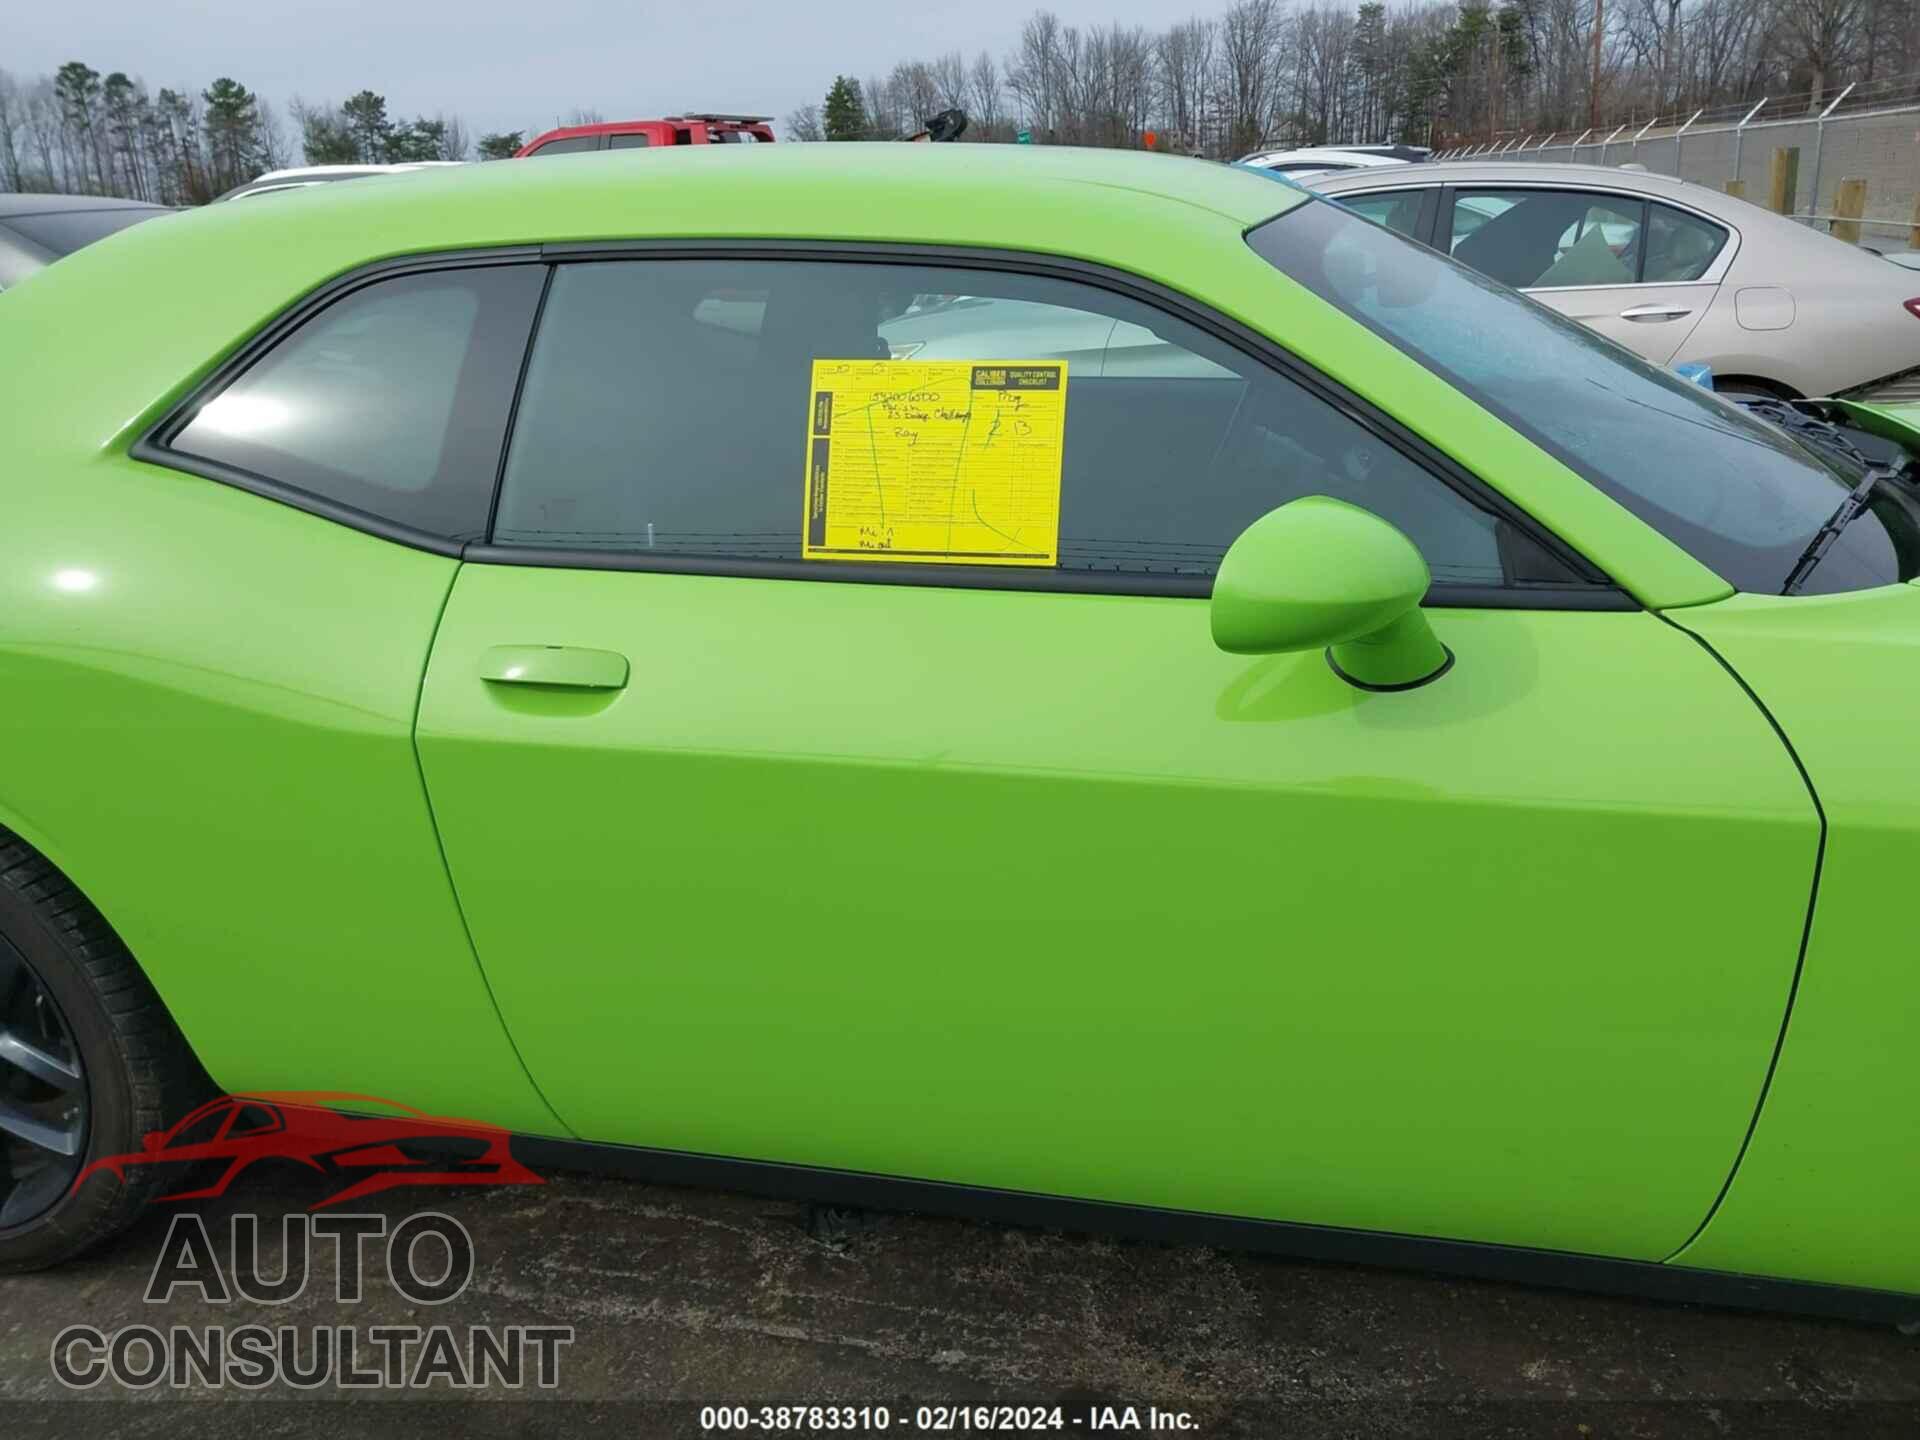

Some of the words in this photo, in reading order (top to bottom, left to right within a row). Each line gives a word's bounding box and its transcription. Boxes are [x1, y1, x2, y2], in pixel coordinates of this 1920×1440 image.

[975, 369, 1006, 378] CALIBER
[1009, 371, 1031, 379] QUALITY
[1031, 371, 1057, 379] CONTROL
[1018, 378, 1048, 386] CHECKLIST
